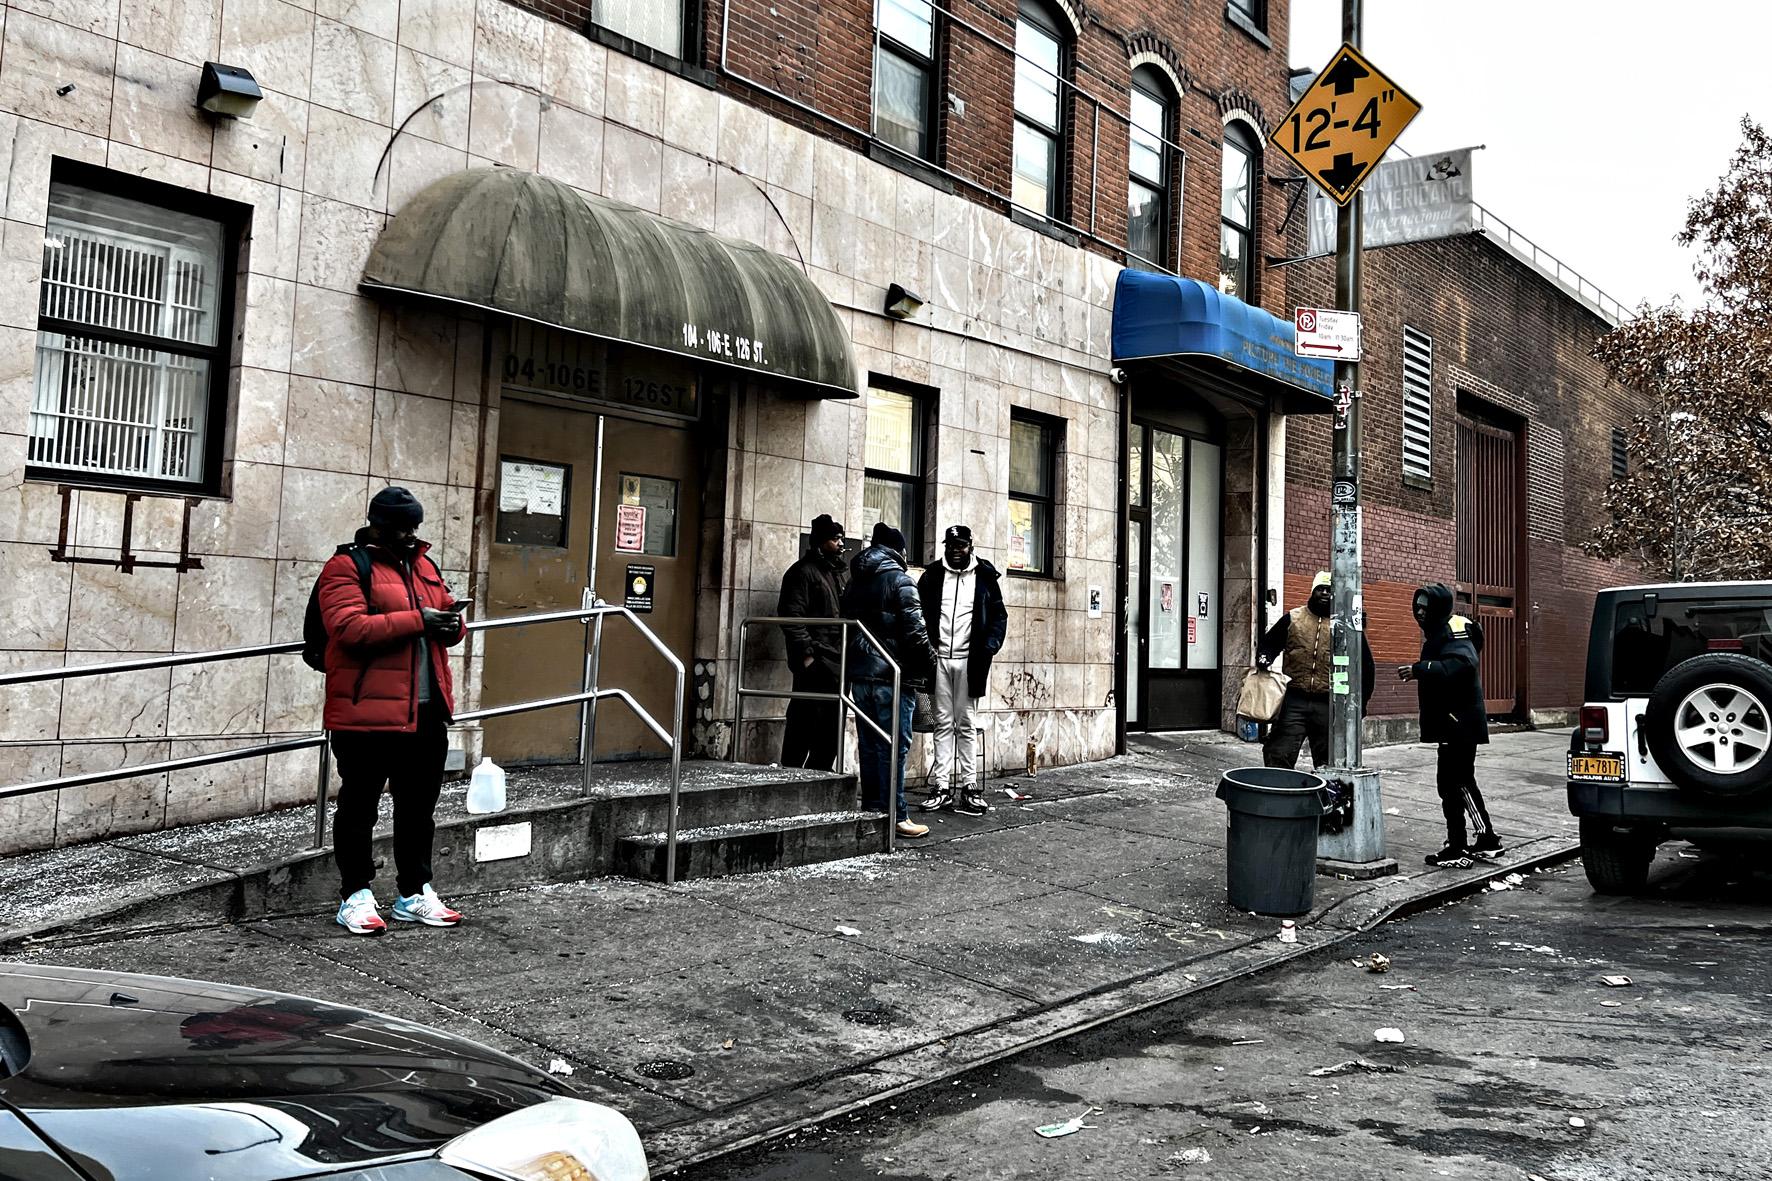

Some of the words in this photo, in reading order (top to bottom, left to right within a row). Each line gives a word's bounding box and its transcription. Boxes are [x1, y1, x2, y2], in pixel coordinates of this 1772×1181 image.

[1318, 315, 1338, 325] Tuesday
[1318, 322, 1334, 331] Friday
[682, 322, 698, 349] 104
[735, 336, 751, 361] 126
